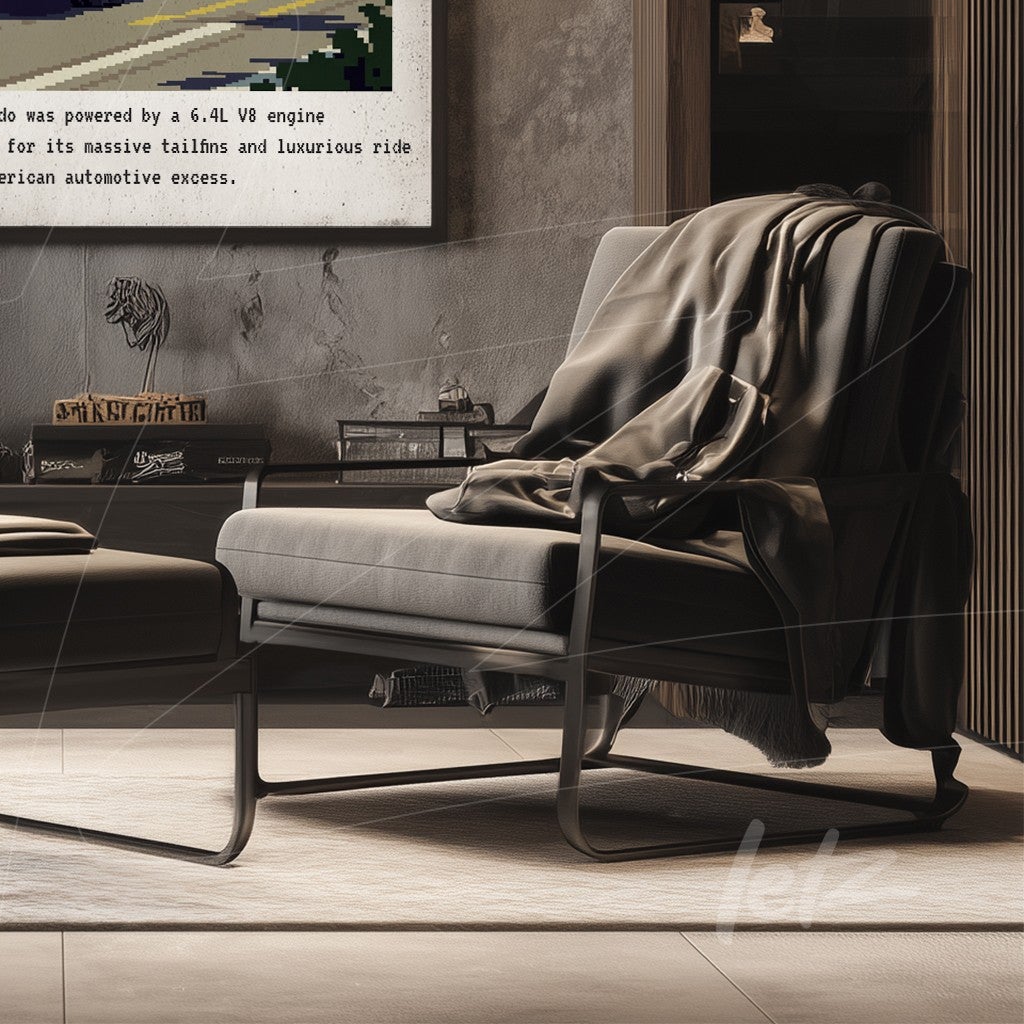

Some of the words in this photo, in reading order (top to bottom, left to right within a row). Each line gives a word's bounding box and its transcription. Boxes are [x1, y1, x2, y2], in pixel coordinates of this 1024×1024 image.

[26, 111, 55, 123] was
[65, 107, 132, 127] powered
[141, 107, 161, 127] by
[170, 111, 180, 123] a
[190, 107, 229, 123] 6.4L
[238, 107, 256, 123] V8
[267, 107, 325, 127] engine
[8, 138, 36, 154] for
[46, 138, 74, 154] its
[84, 138, 152, 154] massive
[161, 138, 228, 154] tailfins
[238, 138, 267, 154] and
[277, 138, 363, 154] luxurious
[373, 138, 411, 154] ride
[65, 169, 161, 185] automotive
[171, 173, 236, 185] excess.
